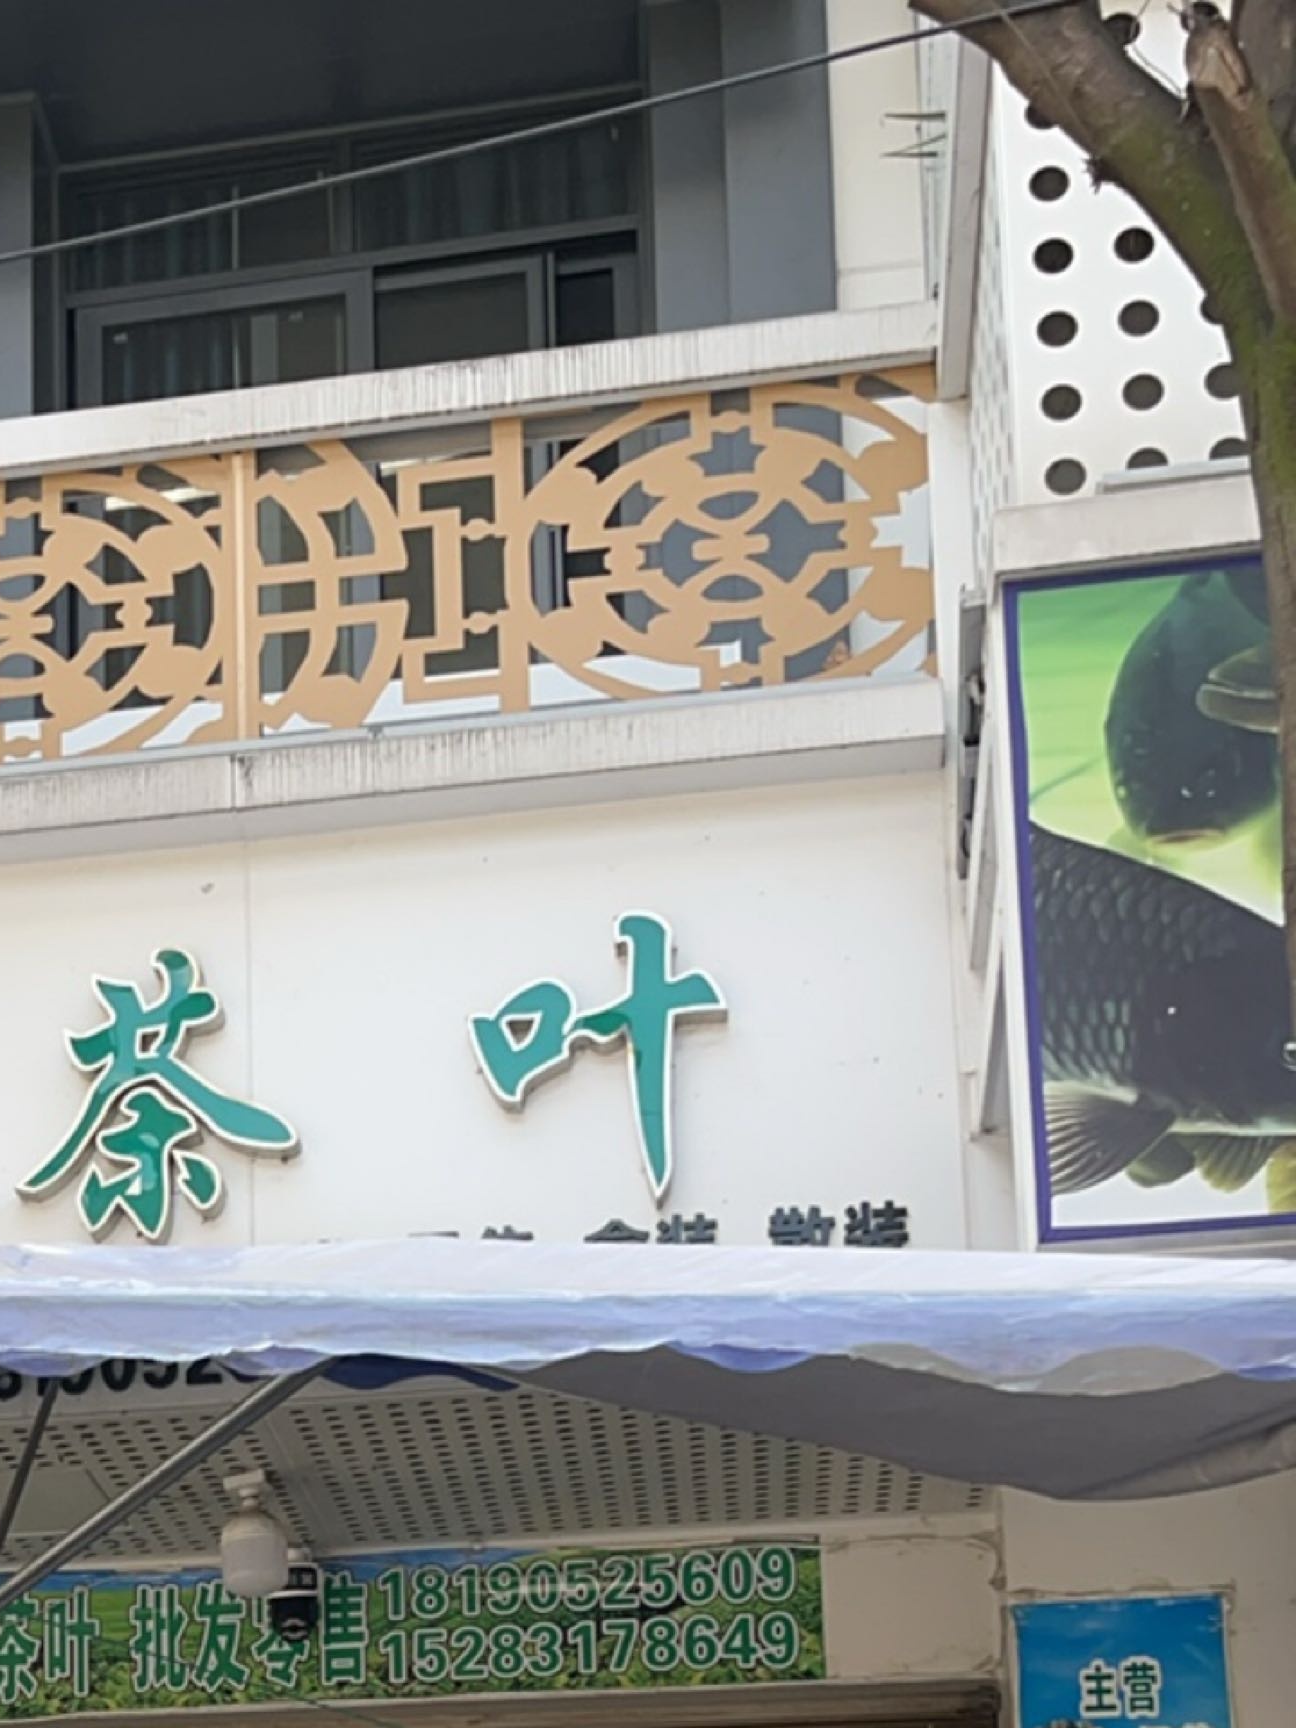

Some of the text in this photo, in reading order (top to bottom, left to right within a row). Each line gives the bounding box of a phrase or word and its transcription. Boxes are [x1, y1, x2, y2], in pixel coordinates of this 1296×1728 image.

[379, 1546, 796, 1620] 18190525609
[379, 1611, 801, 1684] 15283178649
[1080, 1656, 1161, 1719] 主营
